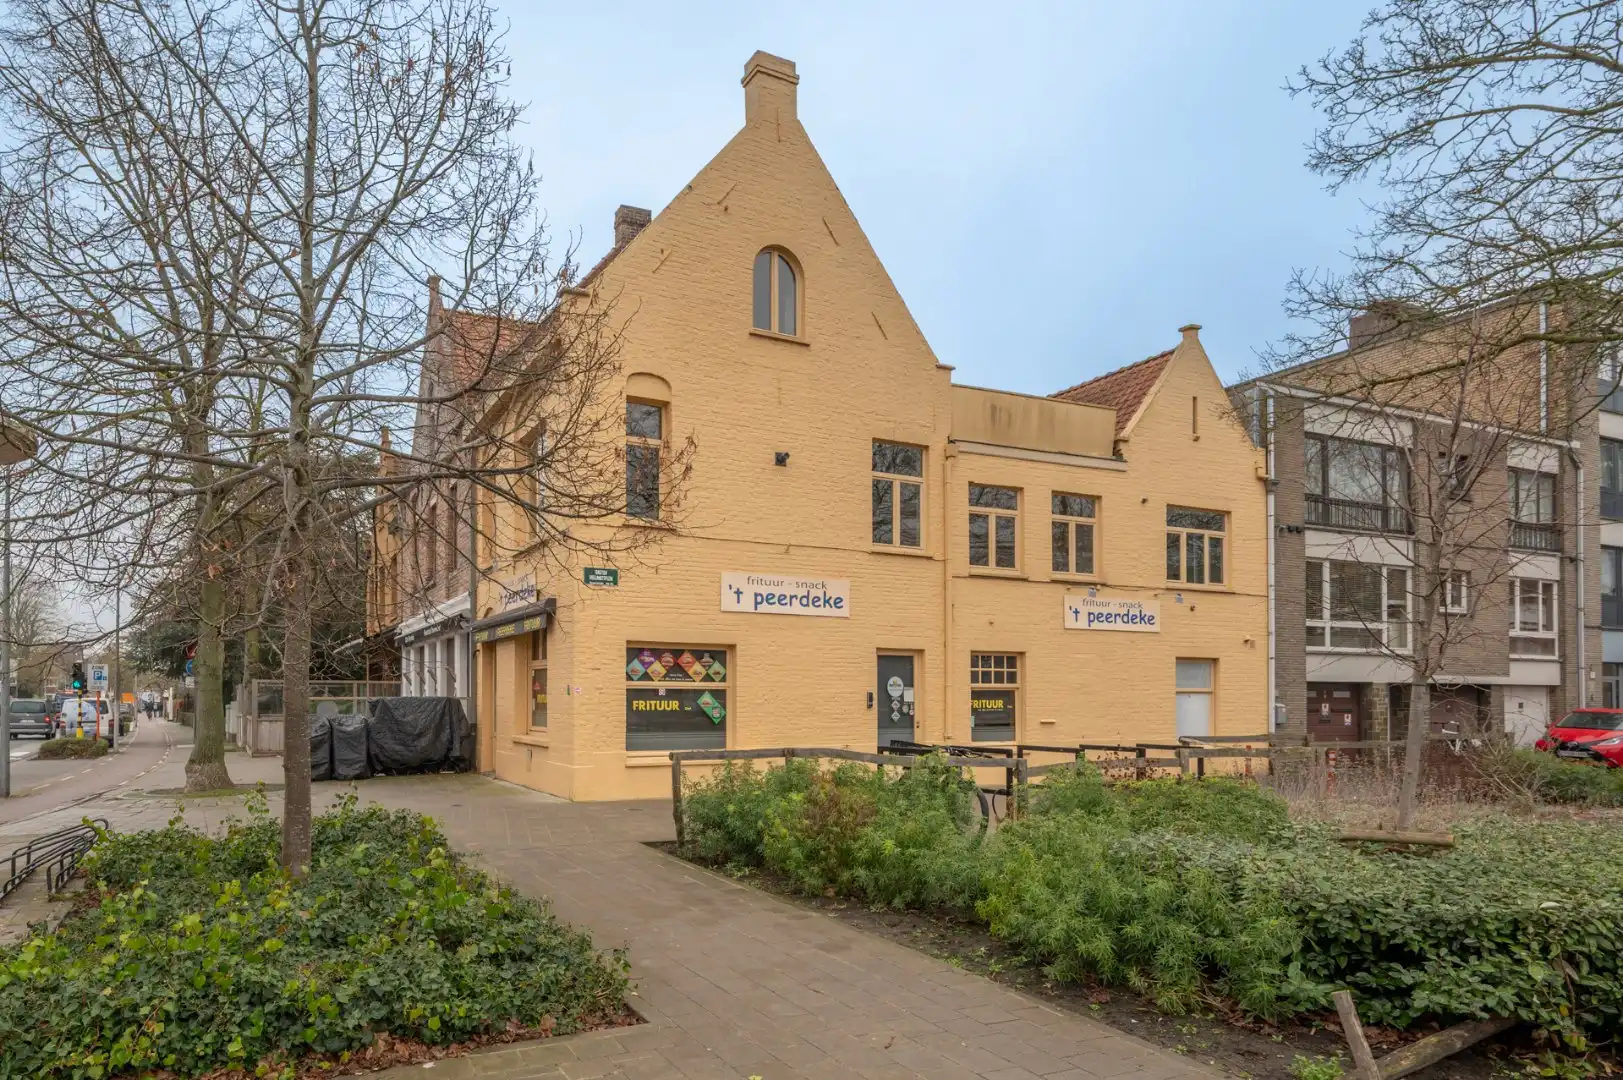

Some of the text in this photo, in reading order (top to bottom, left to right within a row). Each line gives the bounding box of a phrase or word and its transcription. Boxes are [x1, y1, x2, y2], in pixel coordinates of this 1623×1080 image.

[747, 576, 784, 587] frituur
[795, 581, 828, 590] snack
[728, 584, 844, 611] 't peerdeke
[1082, 598, 1111, 607] frituur
[1118, 601, 1143, 609] snack
[1087, 609, 1155, 627] peerdeke
[632, 700, 680, 711] FRITUUR
